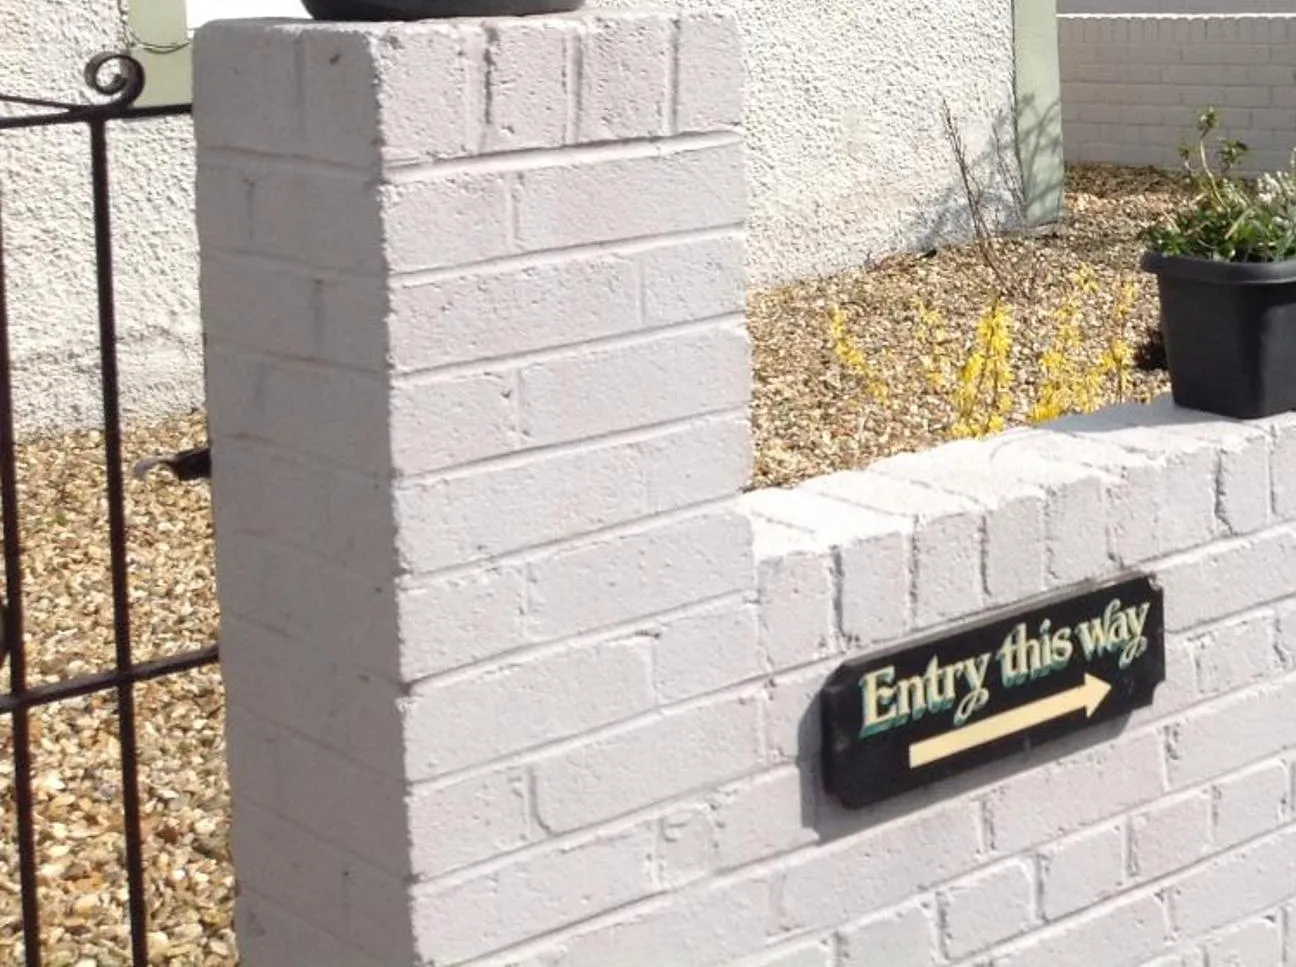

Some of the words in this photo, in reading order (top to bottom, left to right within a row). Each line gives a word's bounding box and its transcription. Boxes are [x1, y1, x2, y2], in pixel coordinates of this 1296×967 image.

[859, 651, 991, 740] Entry
[996, 618, 1074, 688] this
[1077, 597, 1151, 669] way
